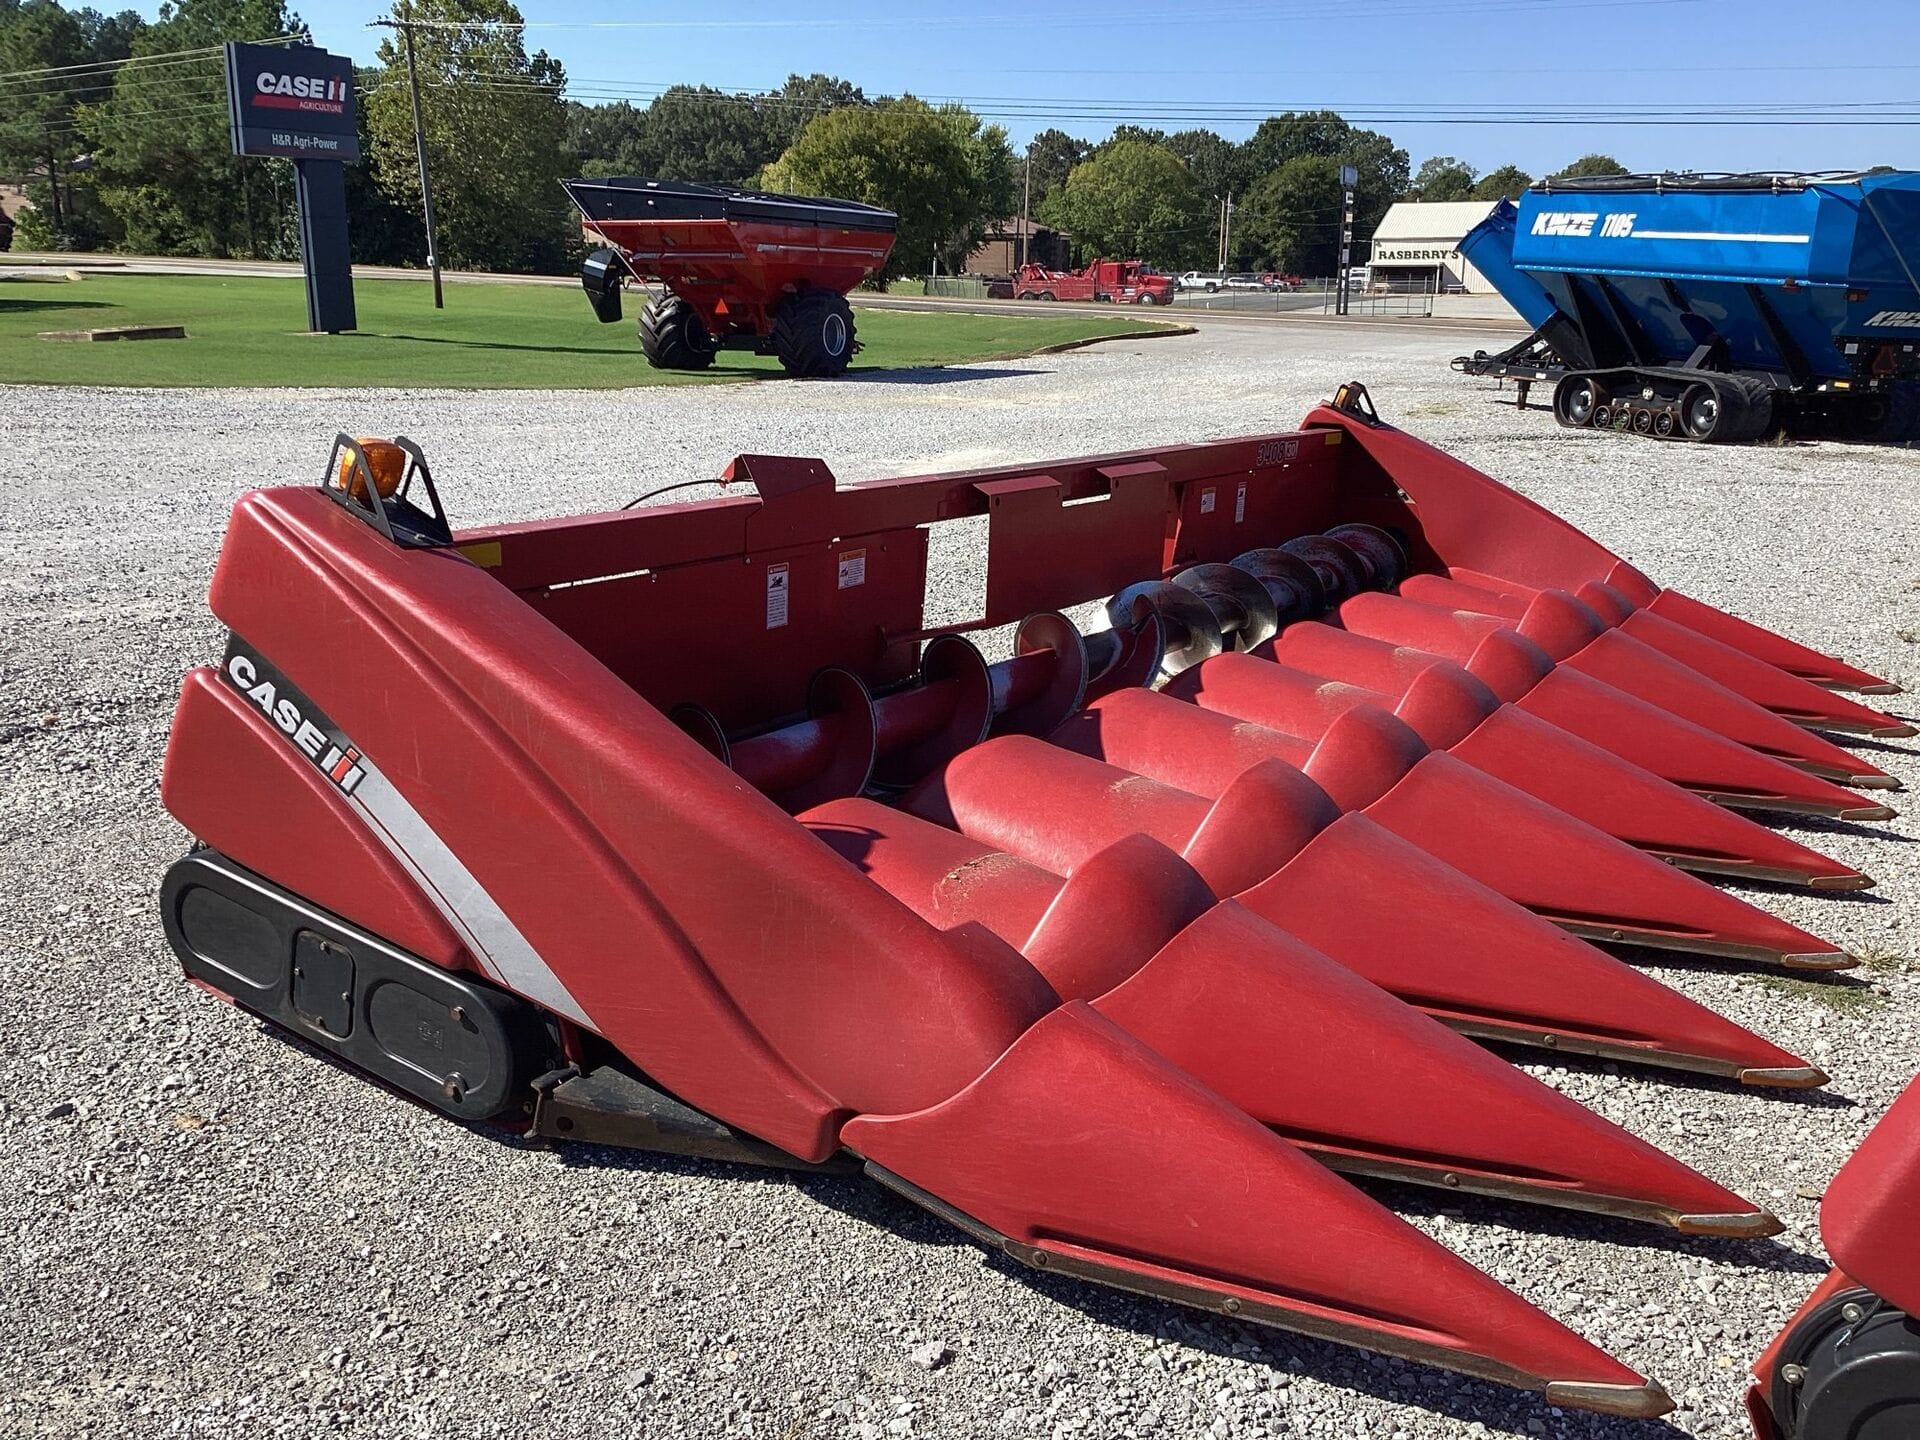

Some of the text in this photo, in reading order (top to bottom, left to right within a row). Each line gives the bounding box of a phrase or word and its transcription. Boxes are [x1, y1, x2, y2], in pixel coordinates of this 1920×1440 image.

[256, 72, 325, 99] CASE
[299, 101, 344, 114] AGRICULTURE
[271, 133, 338, 151] H&R Agri-Power
[1530, 212, 1638, 238] KINZE 1105
[1378, 250, 1460, 260] RASBERRY'S
[1256, 441, 1286, 467] 3408
[228, 655, 329, 759] CASE
